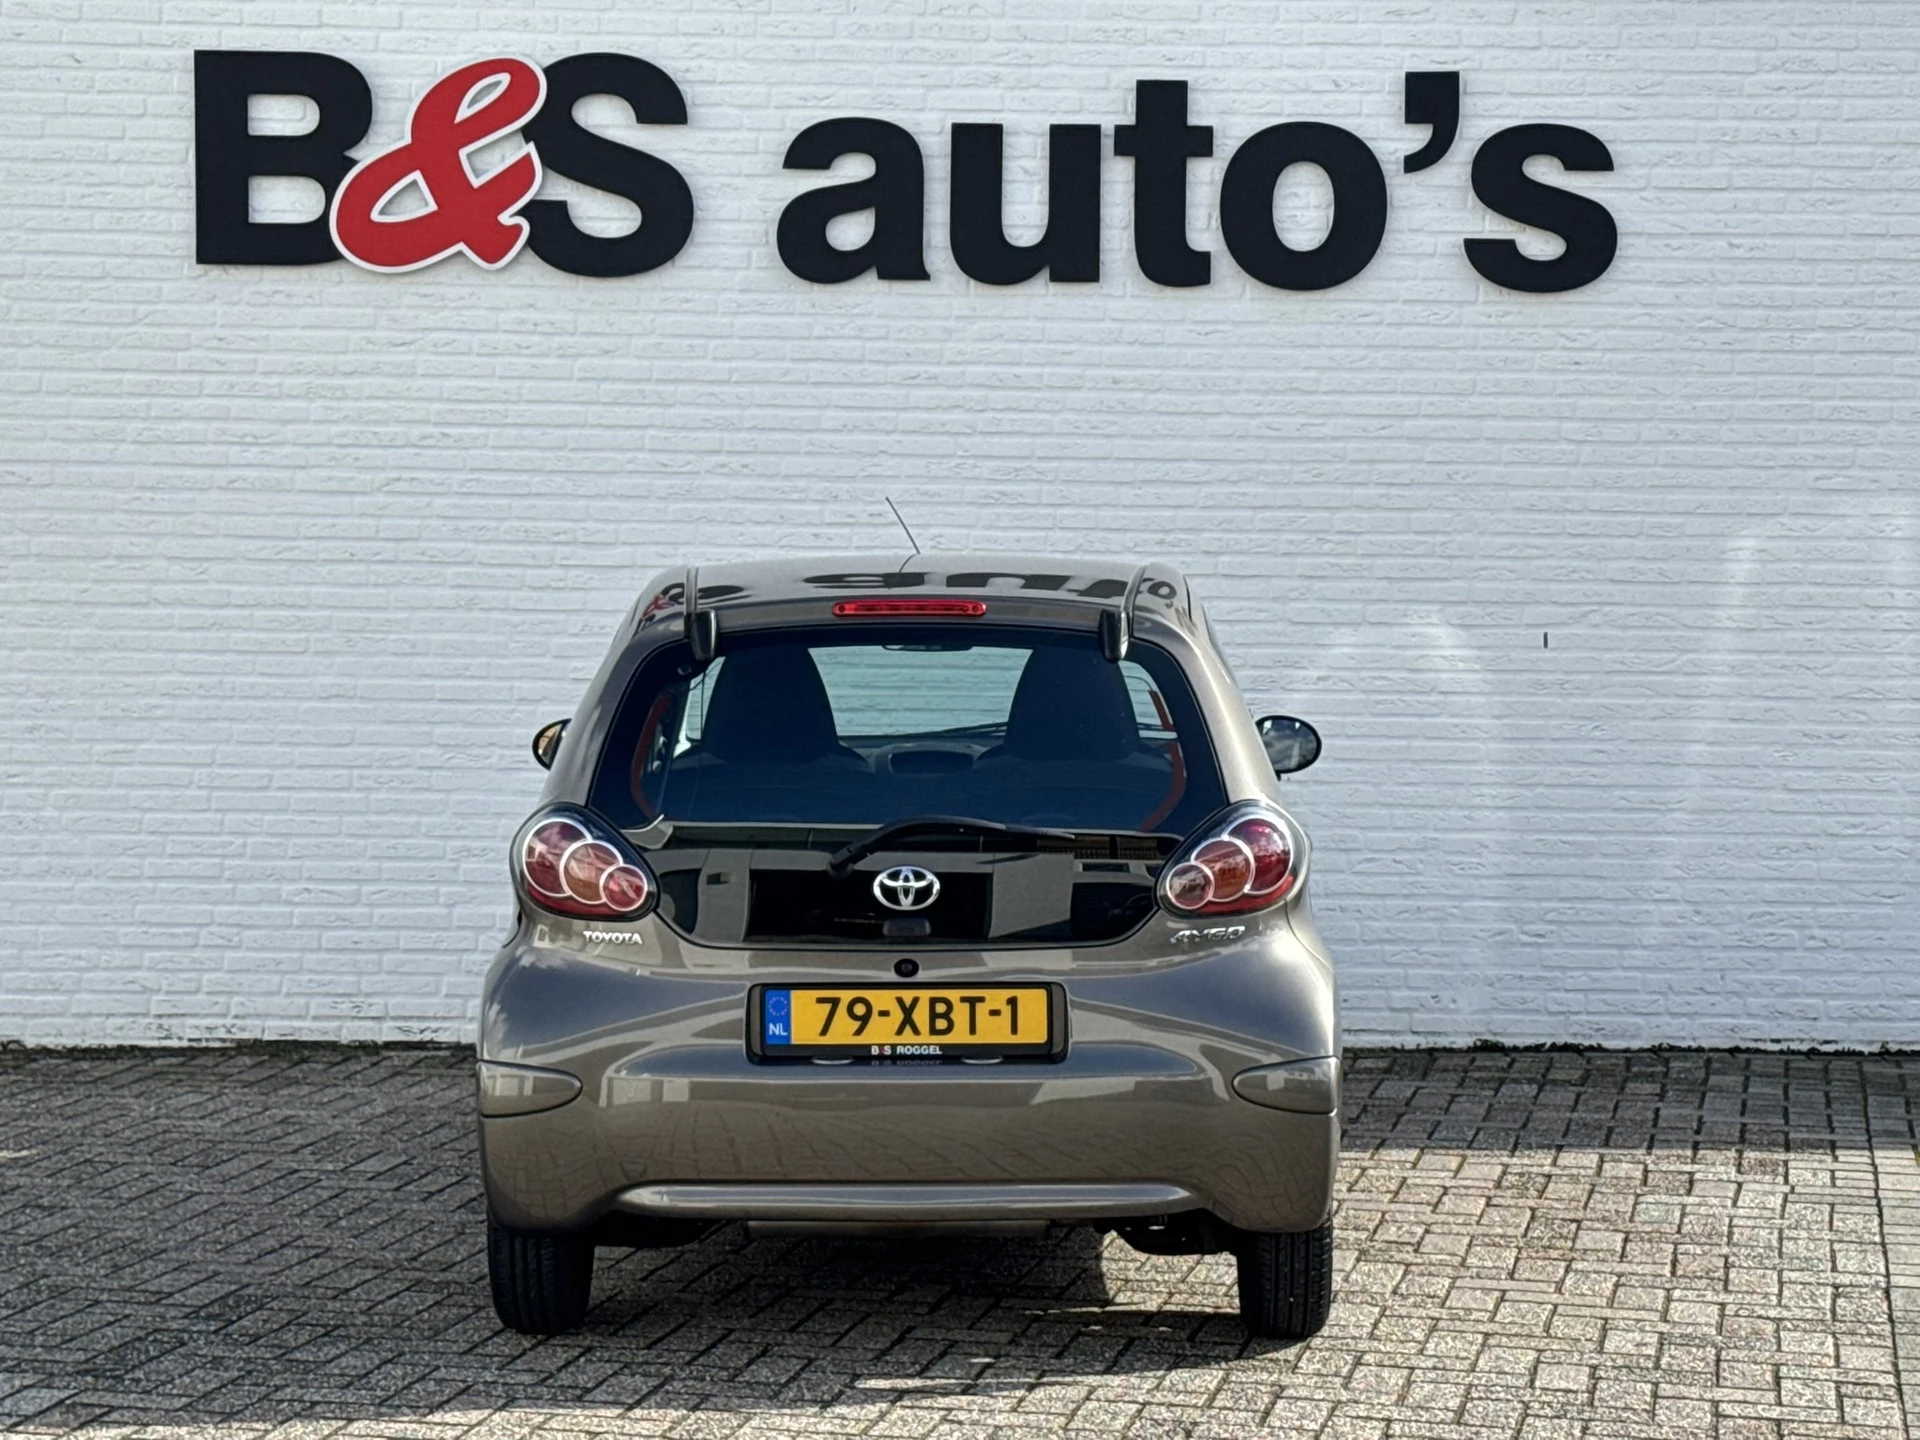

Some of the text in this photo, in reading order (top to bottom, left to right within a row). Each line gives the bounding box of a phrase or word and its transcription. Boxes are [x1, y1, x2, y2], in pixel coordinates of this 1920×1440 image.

[194, 49, 1618, 293] B&S auto's
[582, 930, 643, 946] TOYOTA
[1169, 925, 1246, 944] AYGO
[815, 995, 1019, 1037] 79-XBT-1
[768, 1022, 788, 1036] NL
[896, 1045, 943, 1055] ROGGEL
